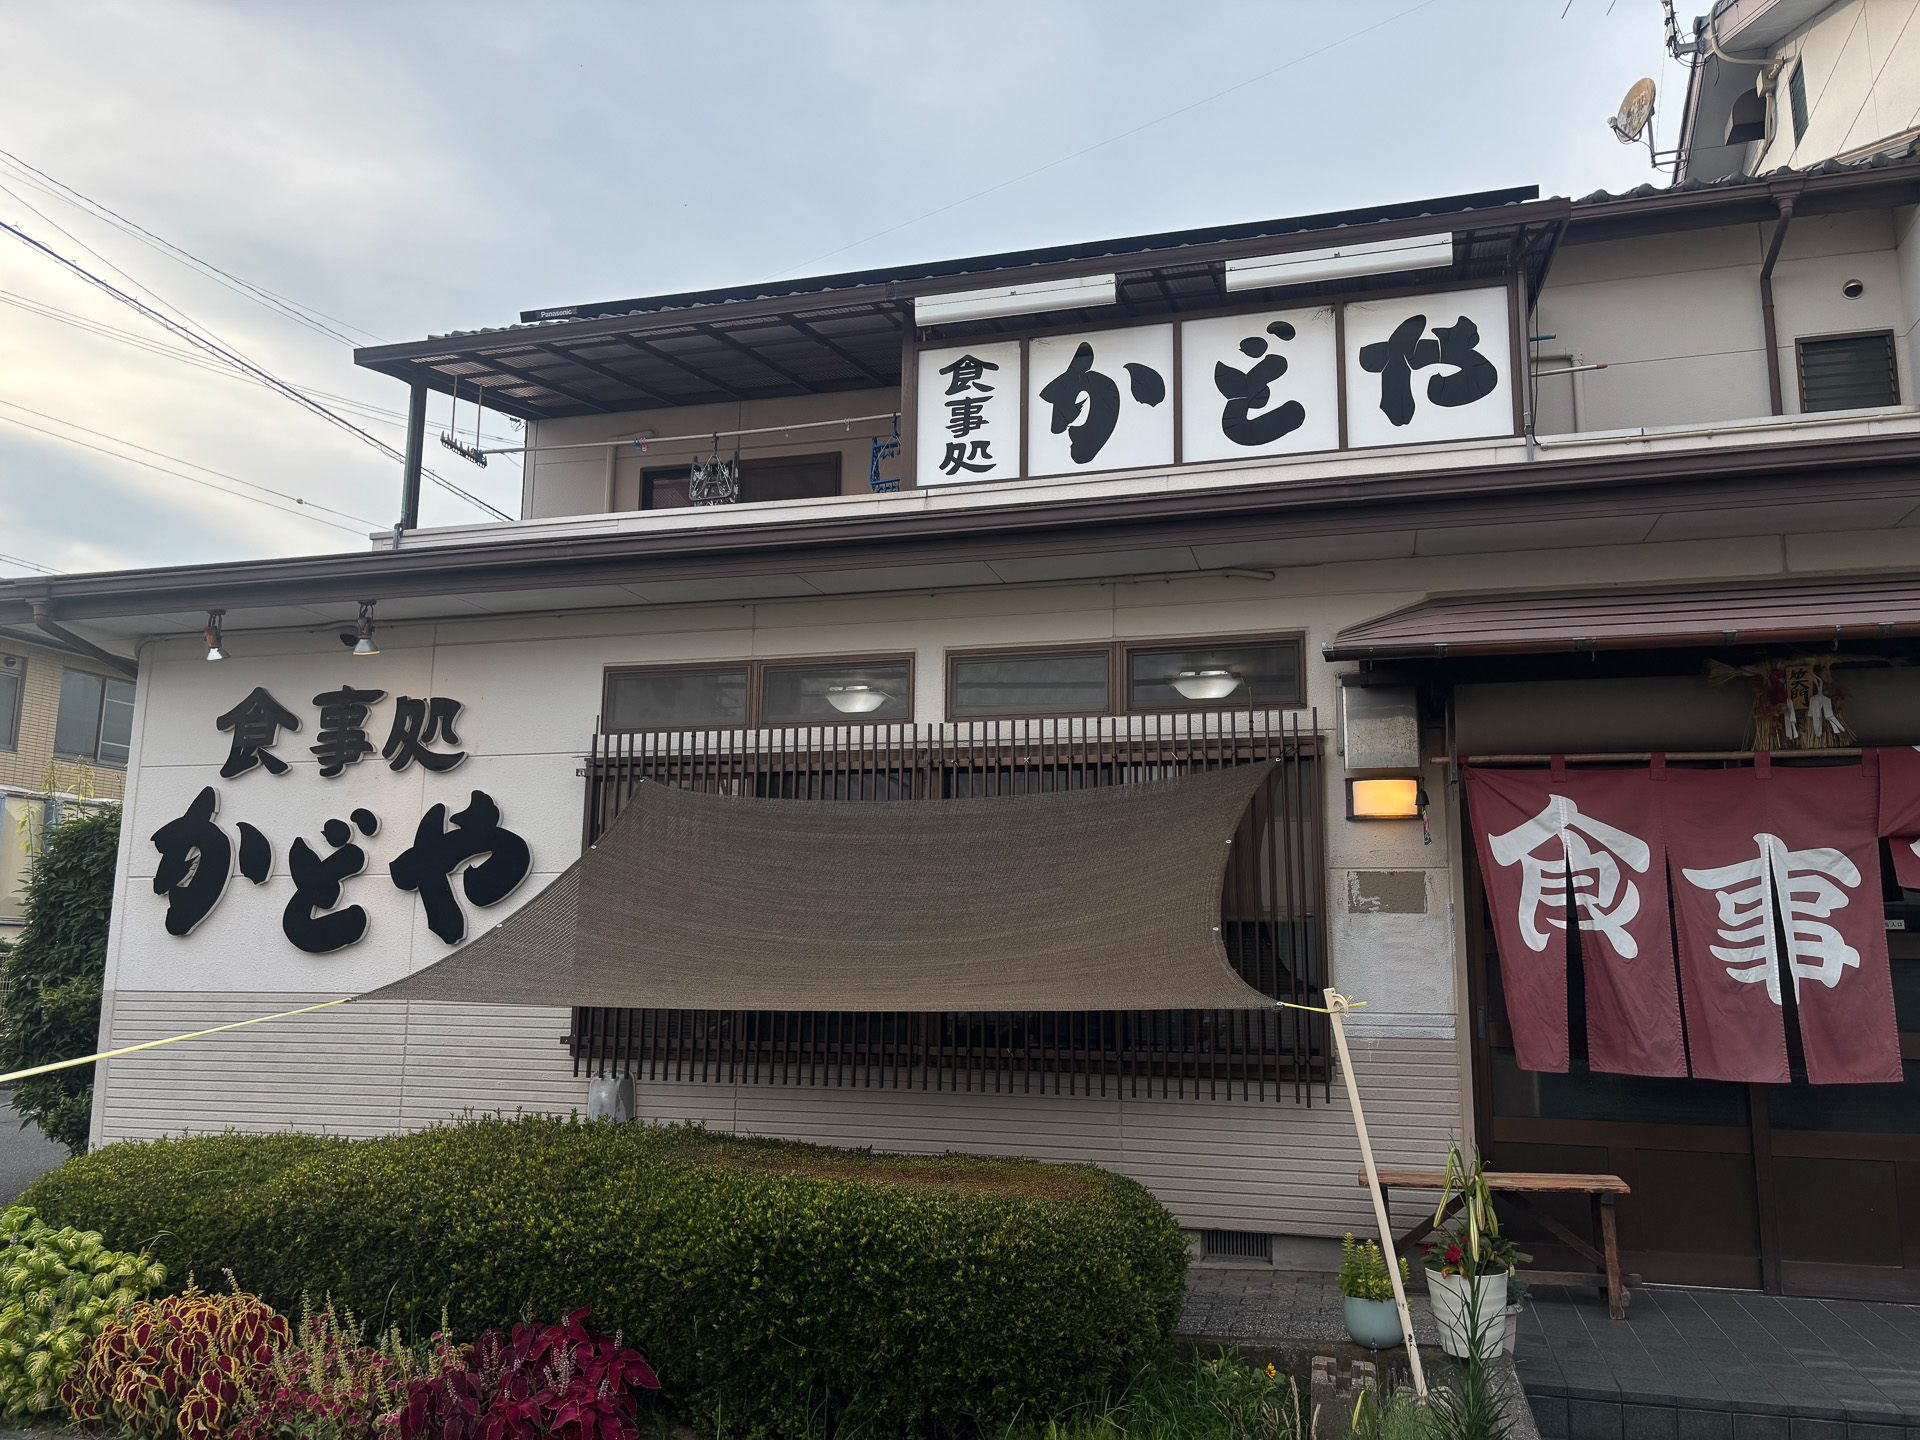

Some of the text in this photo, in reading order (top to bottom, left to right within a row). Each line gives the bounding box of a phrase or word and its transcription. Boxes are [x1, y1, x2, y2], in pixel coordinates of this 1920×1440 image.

[540, 308, 572, 318] Panasonic
[938, 354, 999, 476] 食事処
[1039, 313, 1498, 465] かどや
[216, 685, 469, 779] 食事処
[1790, 668, 1810, 708] 笑門
[150, 785, 535, 954] かどや
[1488, 745, 1920, 1006] 食事
